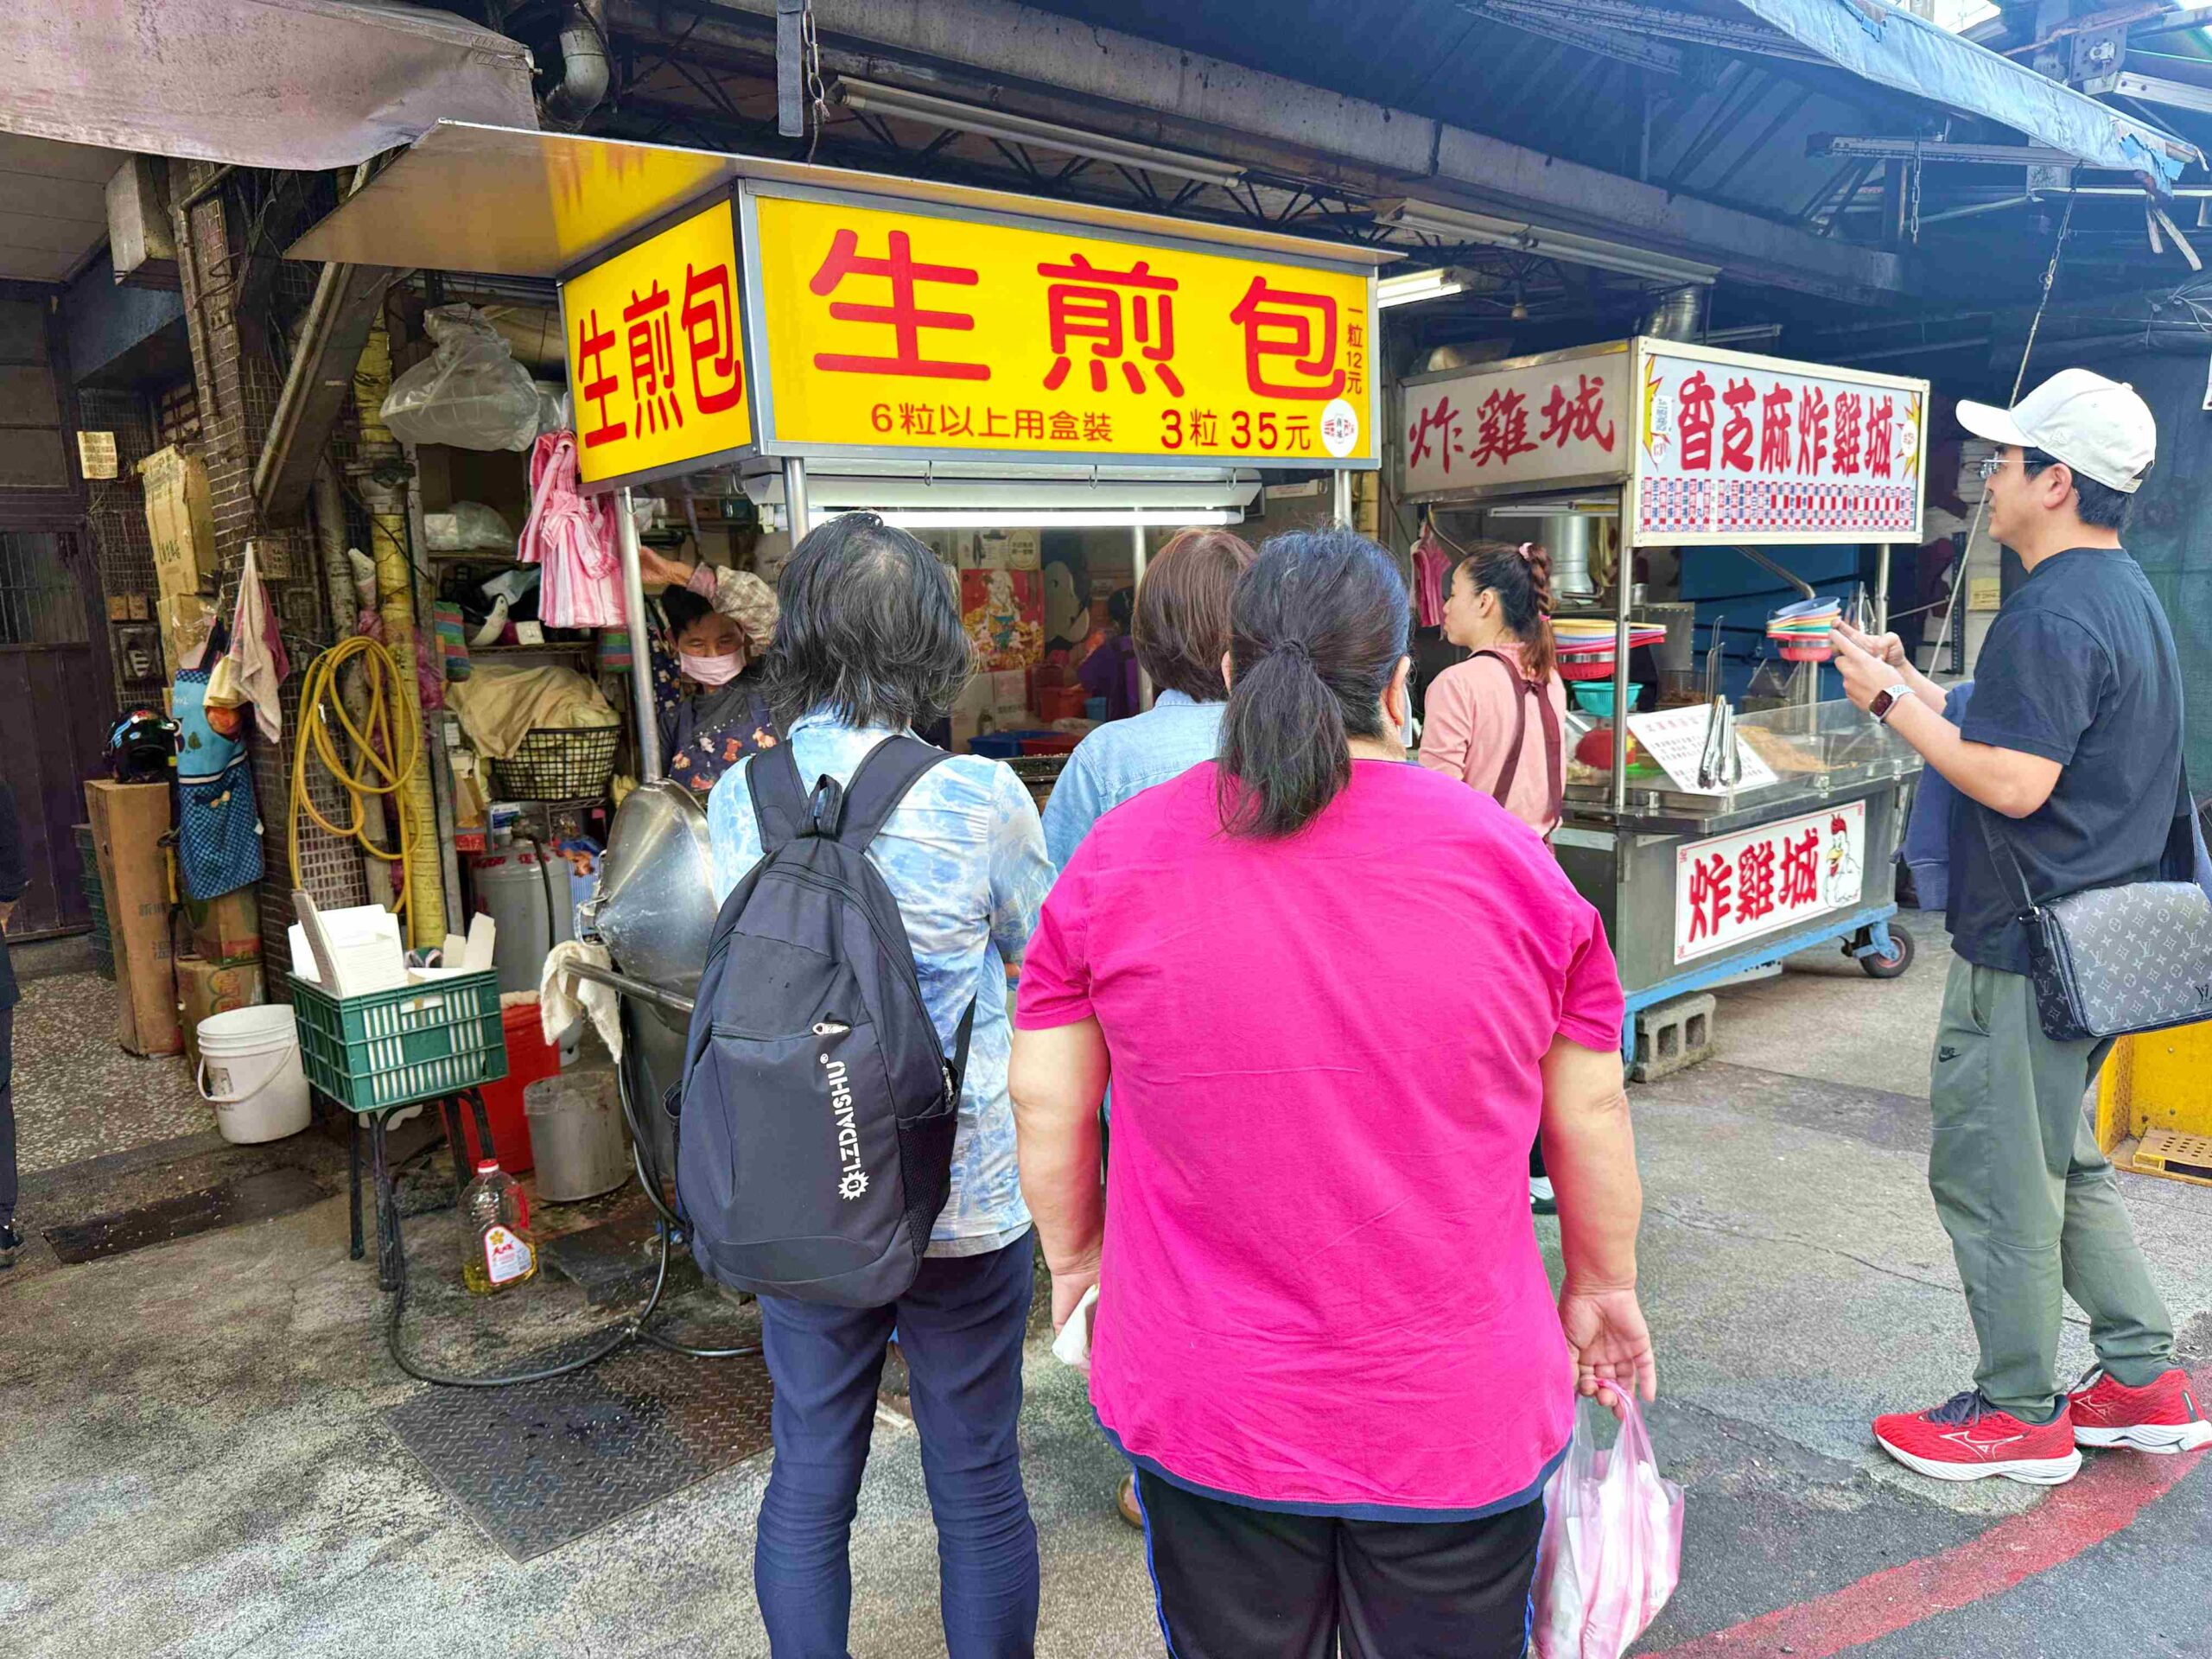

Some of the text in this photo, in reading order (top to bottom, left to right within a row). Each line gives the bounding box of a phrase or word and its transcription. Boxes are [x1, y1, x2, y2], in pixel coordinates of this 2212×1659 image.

[578, 263, 742, 448] 生煎包
[809, 228, 1345, 401] 生煎包
[1346, 307, 1363, 395] 一粒12元
[870, 403, 1113, 442] 6粒以上用盒裝
[1409, 375, 1614, 474] 炸雞城
[1678, 370, 1892, 479] 香芝麻炸雞城
[1688, 828, 1819, 943] 炸雞城
